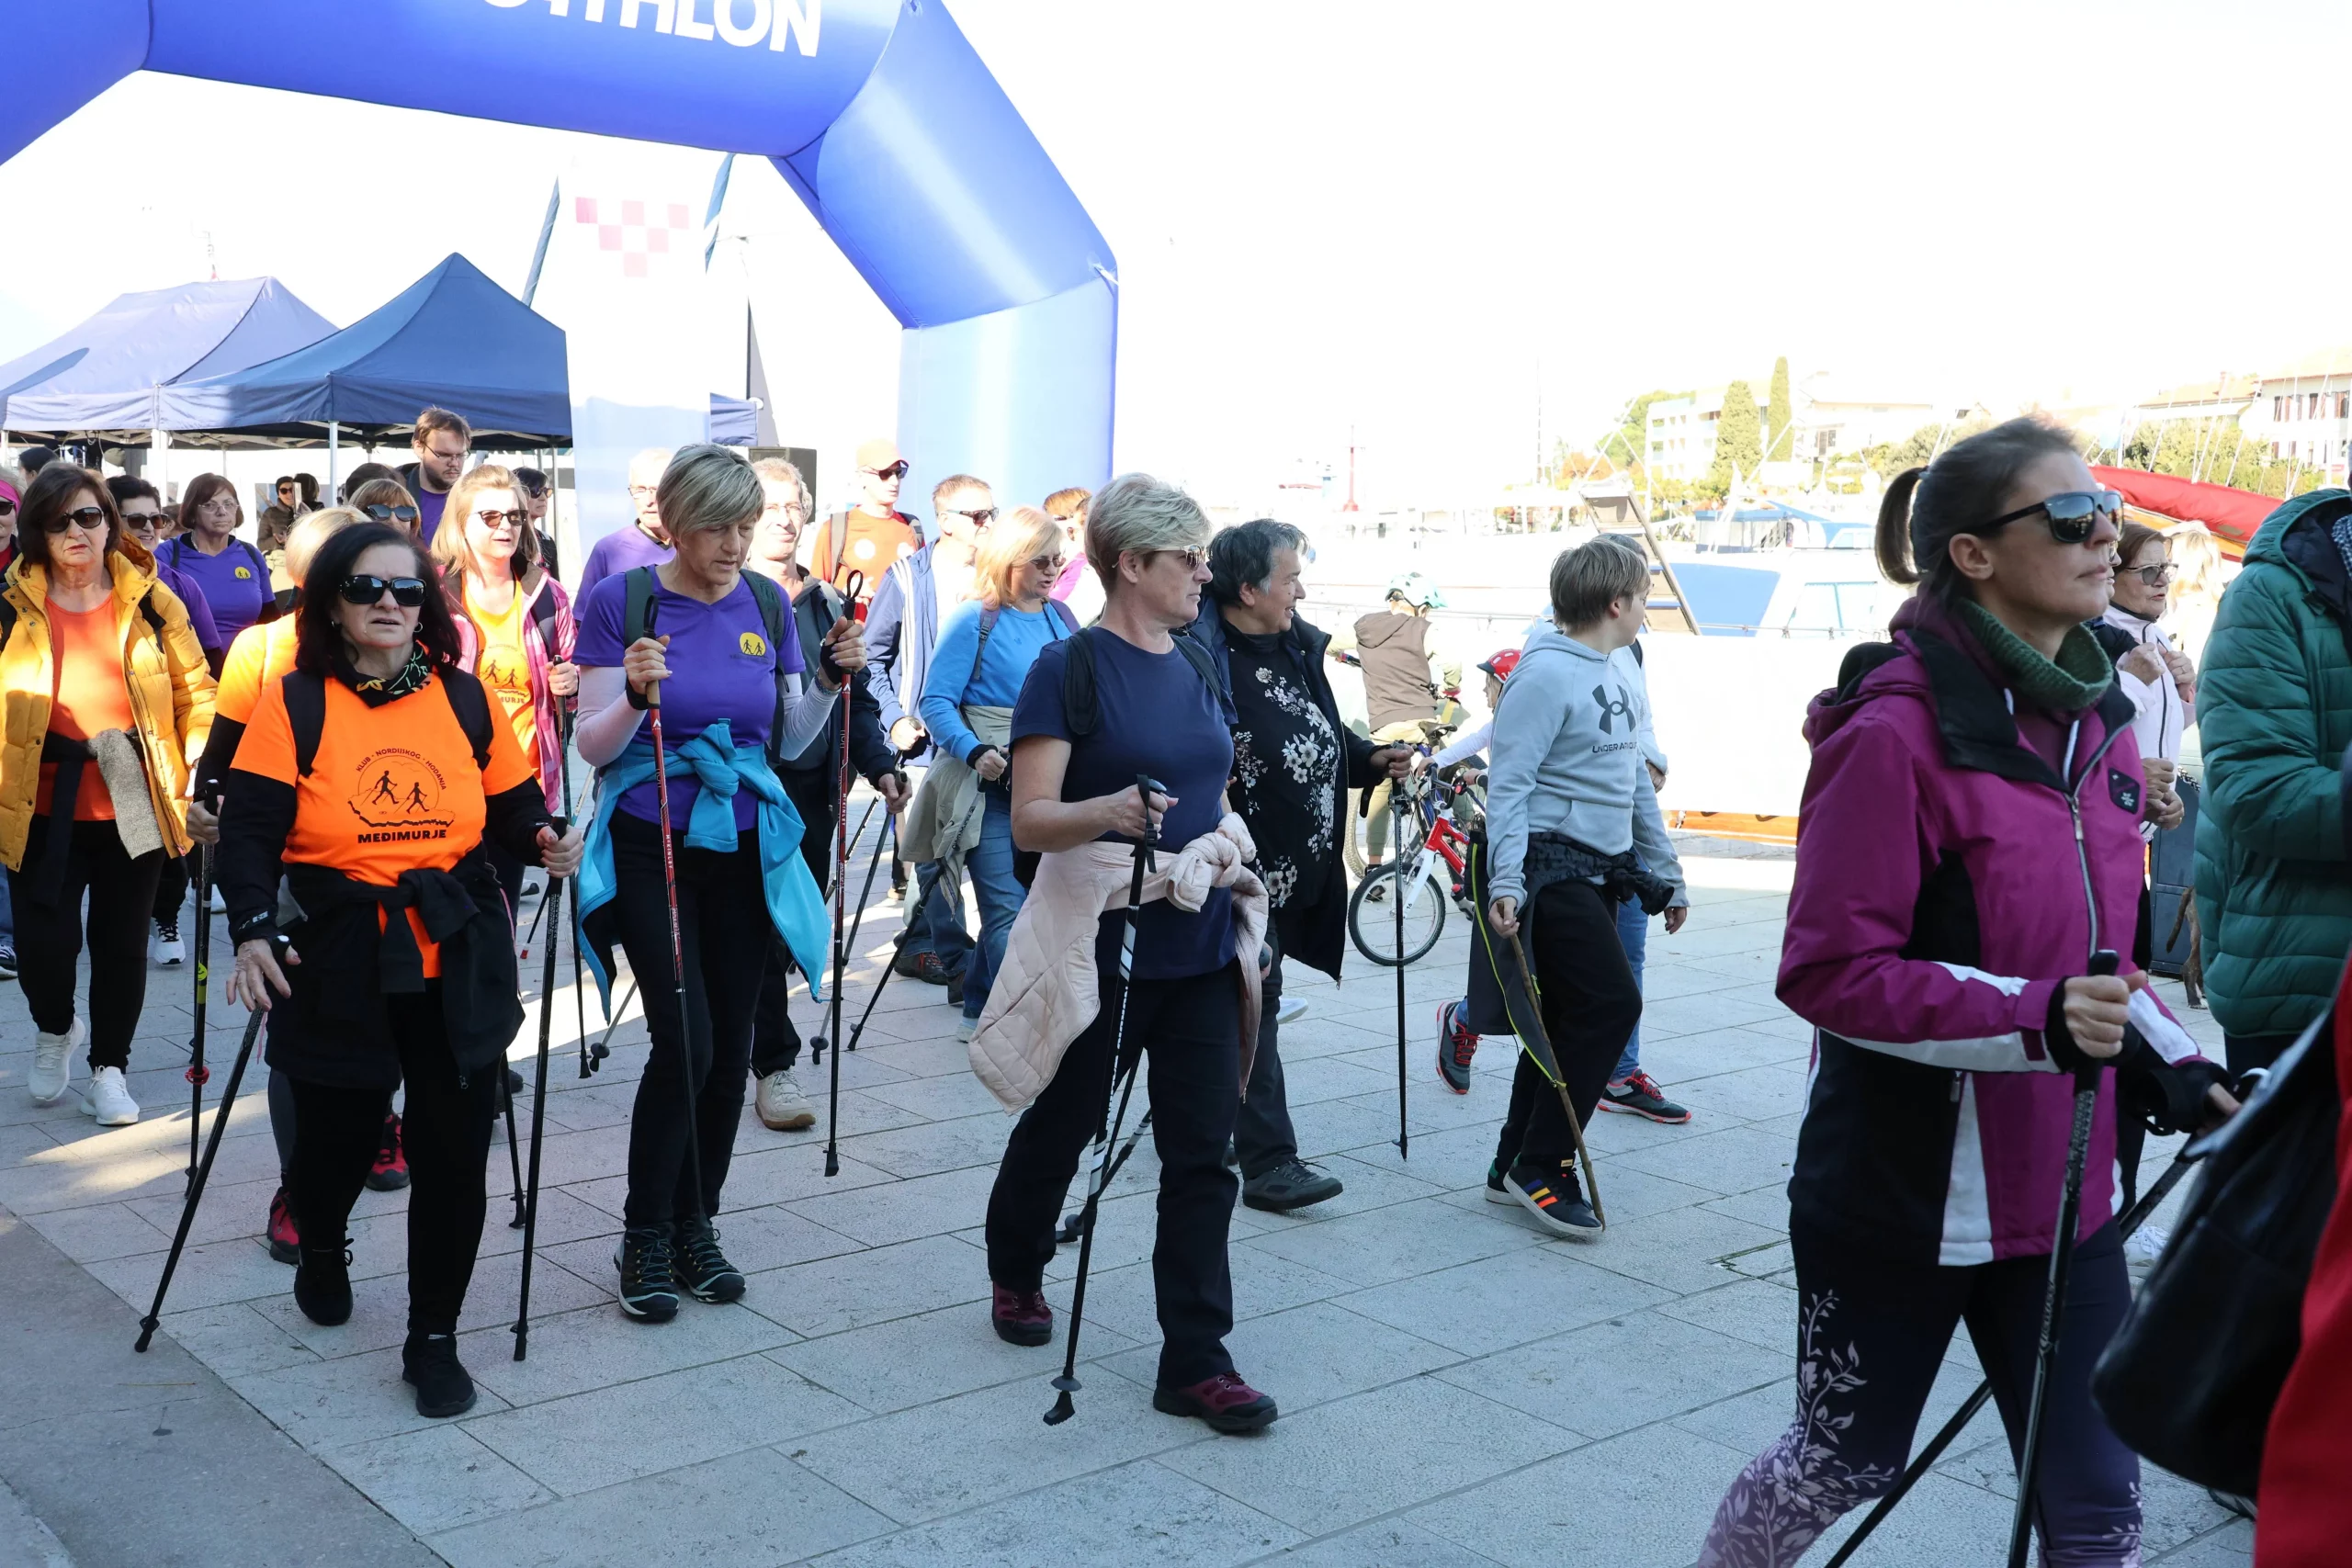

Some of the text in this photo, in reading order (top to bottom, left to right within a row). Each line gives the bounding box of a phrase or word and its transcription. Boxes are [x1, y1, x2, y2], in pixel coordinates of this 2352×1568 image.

[1592, 743, 1618, 753] UNDER
[356, 748, 447, 791] KLUB NORDIJSKOG HODANJA
[357, 829, 447, 843] MEĐIMURJE
